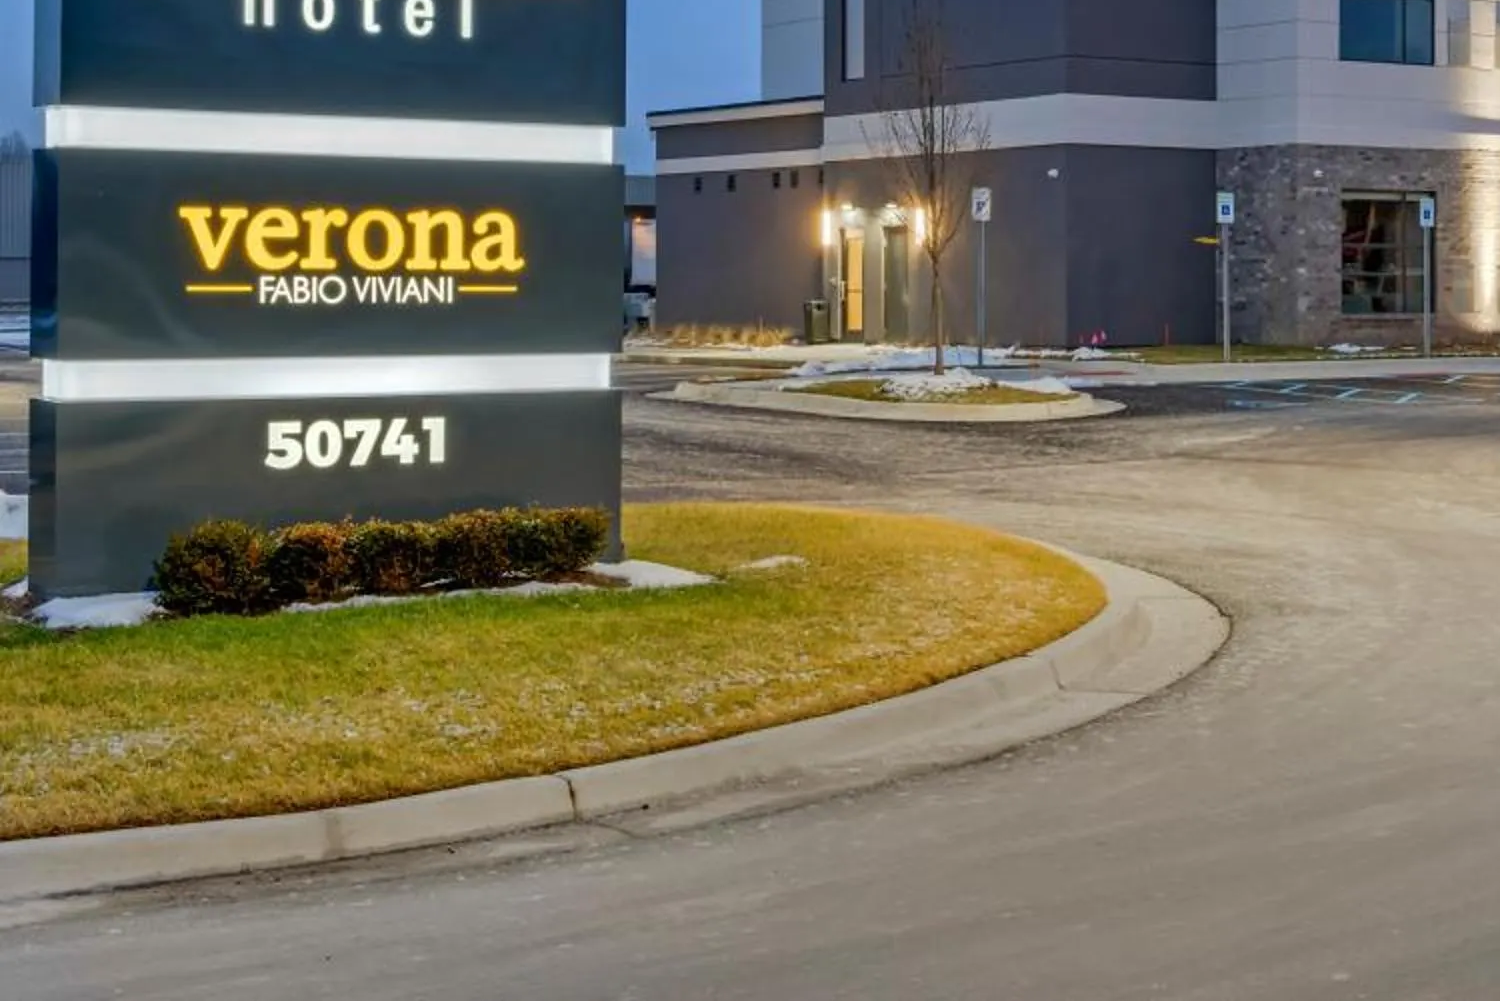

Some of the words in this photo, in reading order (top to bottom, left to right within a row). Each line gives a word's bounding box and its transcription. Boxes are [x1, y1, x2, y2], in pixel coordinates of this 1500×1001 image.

[179, 206, 525, 272] verona
[258, 275, 347, 305] FABIO
[351, 276, 454, 305] VIVIANI
[264, 416, 447, 470] 50741
